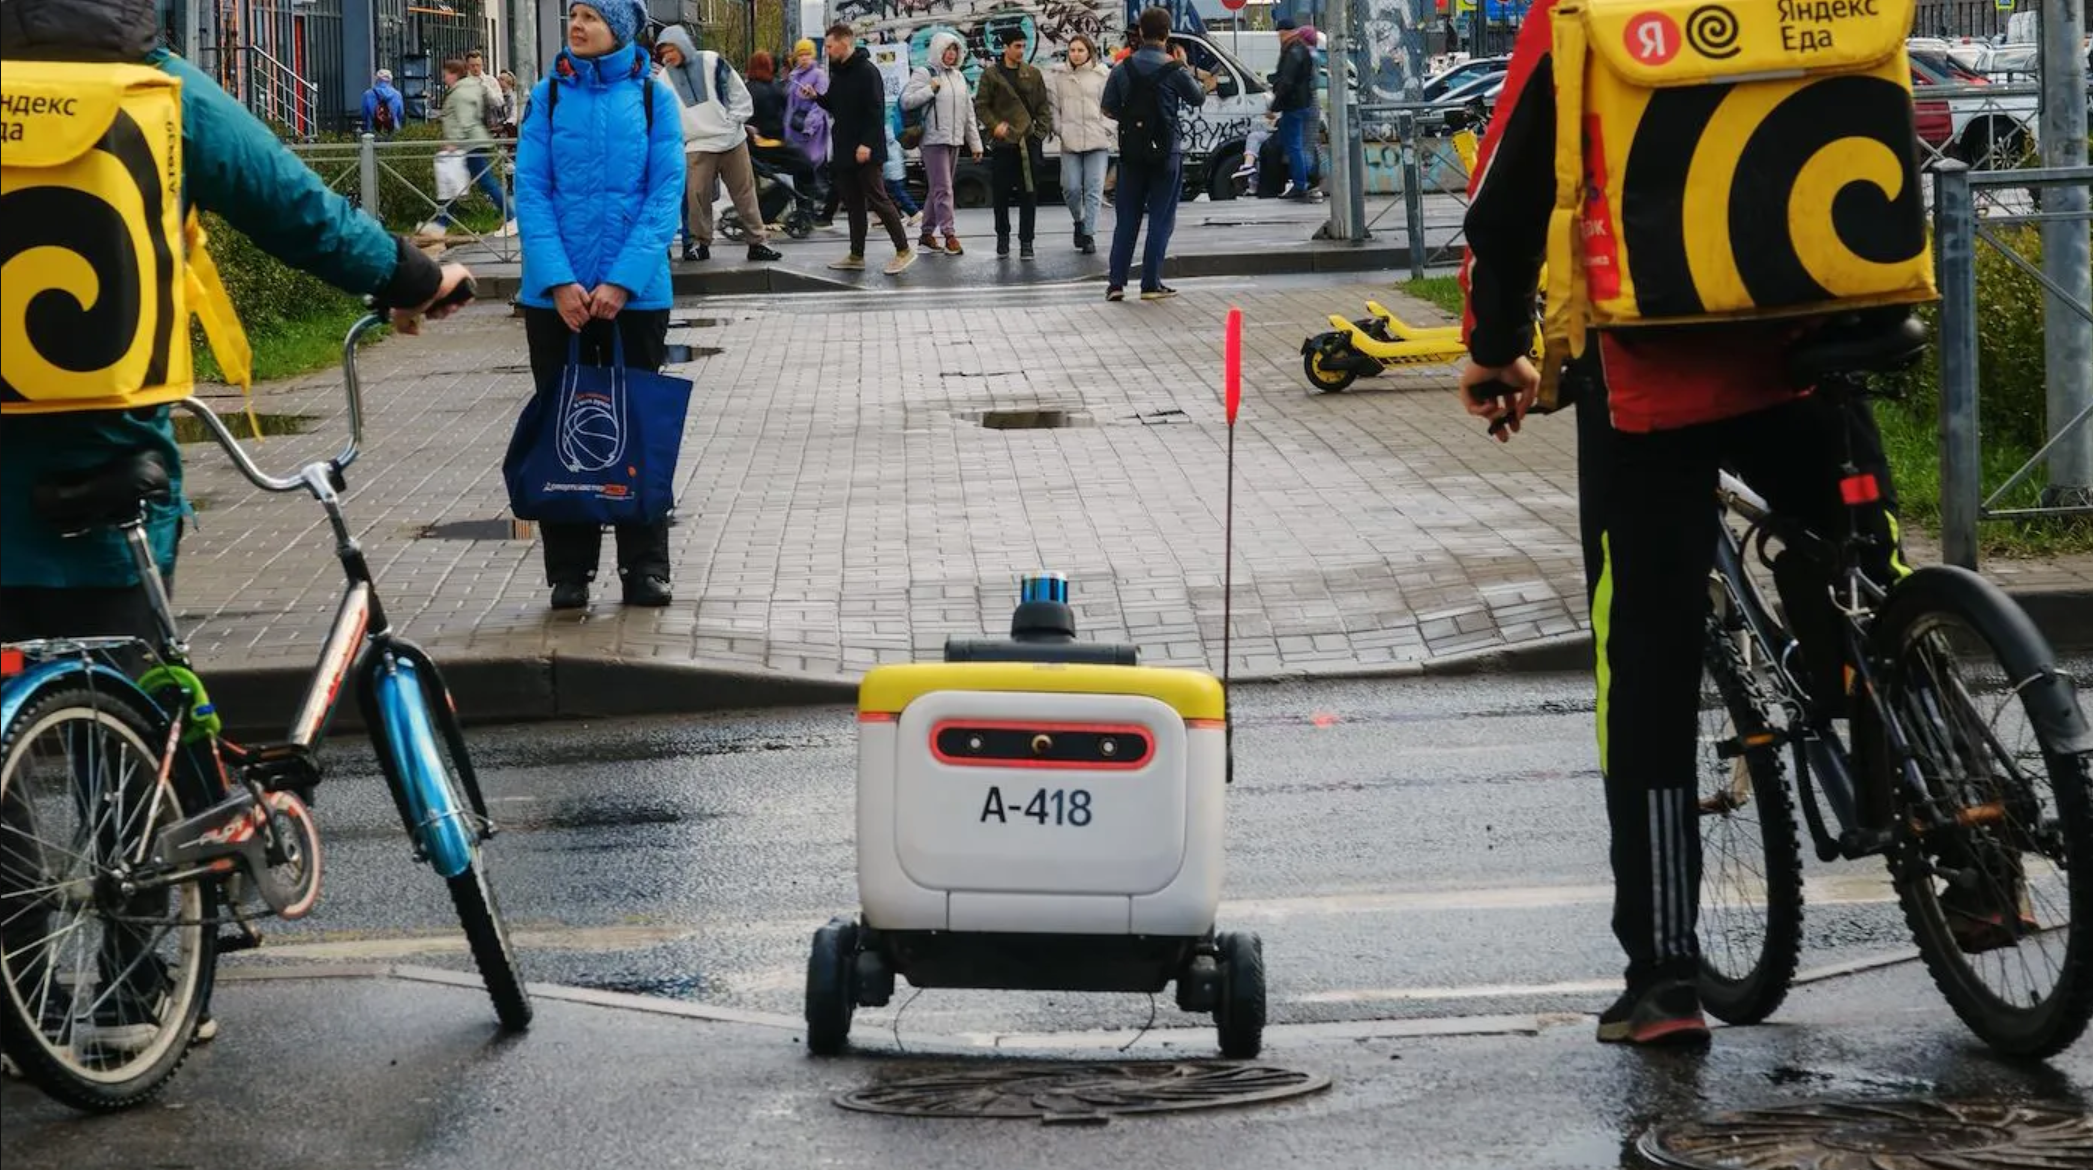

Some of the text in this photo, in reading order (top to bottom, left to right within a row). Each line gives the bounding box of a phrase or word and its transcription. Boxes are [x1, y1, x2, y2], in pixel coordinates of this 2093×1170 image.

[1777, 0, 1879, 23] Яндекс
[1637, 20, 1666, 58] Я
[1781, 25, 1833, 53] Еда
[1, 93, 78, 117] ндекс
[980, 785, 1092, 827] A-418
